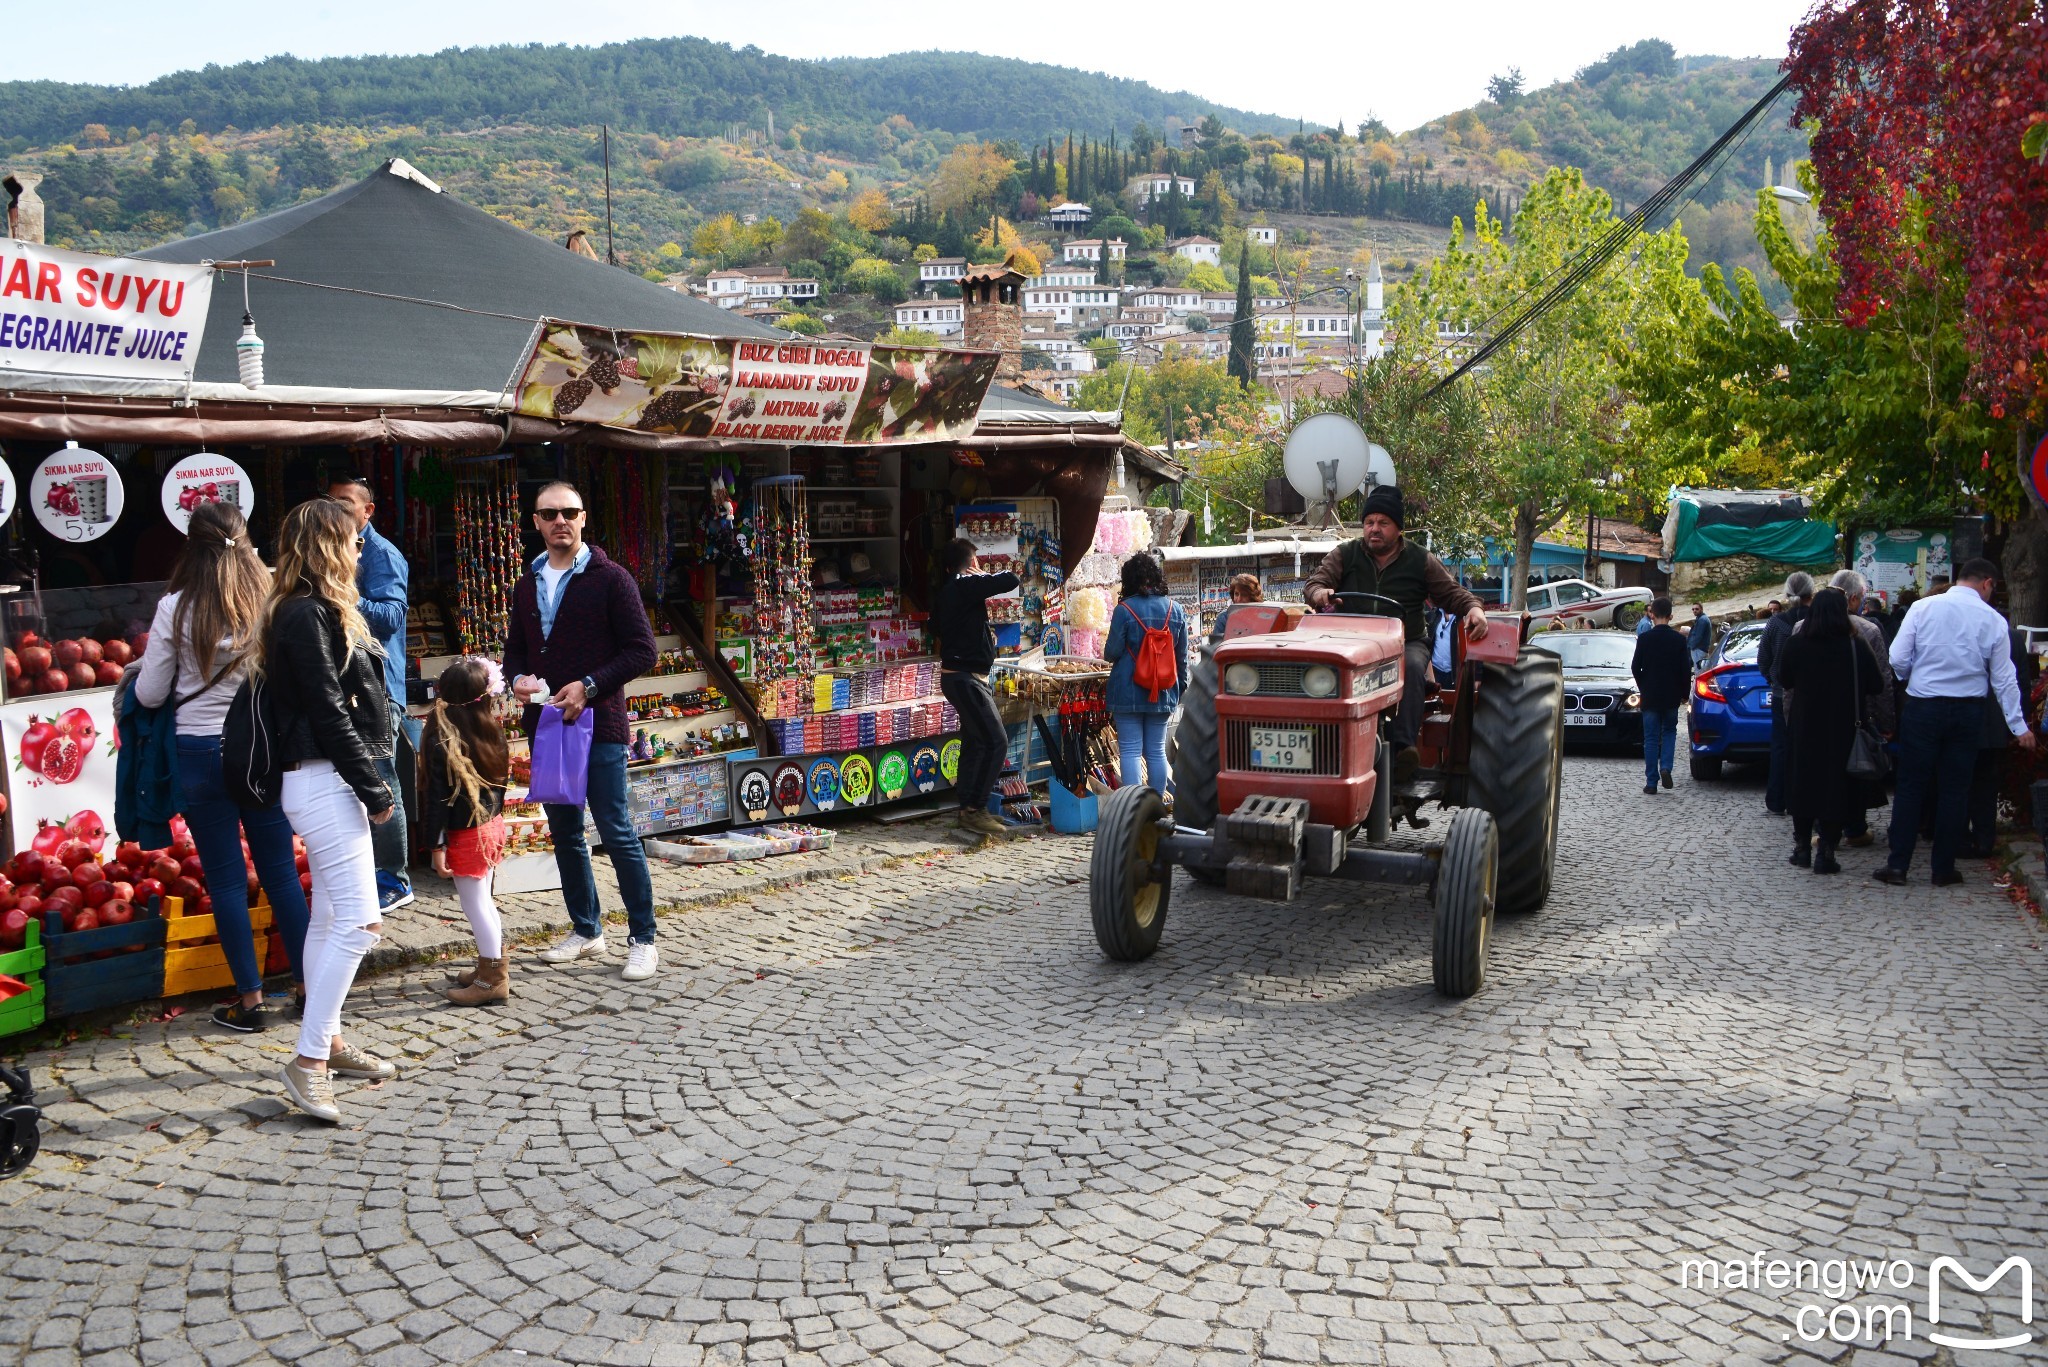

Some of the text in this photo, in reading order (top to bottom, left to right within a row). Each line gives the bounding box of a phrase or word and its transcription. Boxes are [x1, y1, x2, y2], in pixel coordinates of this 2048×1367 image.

[0, 256, 185, 318] AR SUYU
[0, 312, 188, 362] EGRANATE JUICE
[739, 343, 774, 363] BUZ
[814, 346, 865, 368] DOĞAL
[736, 371, 860, 393] KARADUT SUYU
[762, 400, 820, 418] NATURAL
[713, 421, 844, 442] BLACK BERRY JUICE
[44, 461, 104, 476] SIKMA NAR SUYU
[175, 465, 235, 480] SIKMA NAR SUYU
[65, 519, 83, 541] 5
[1588, 715, 1603, 725] 866
[1254, 731, 1309, 749] 35 LBM
[1275, 750, 1294, 766] 19
